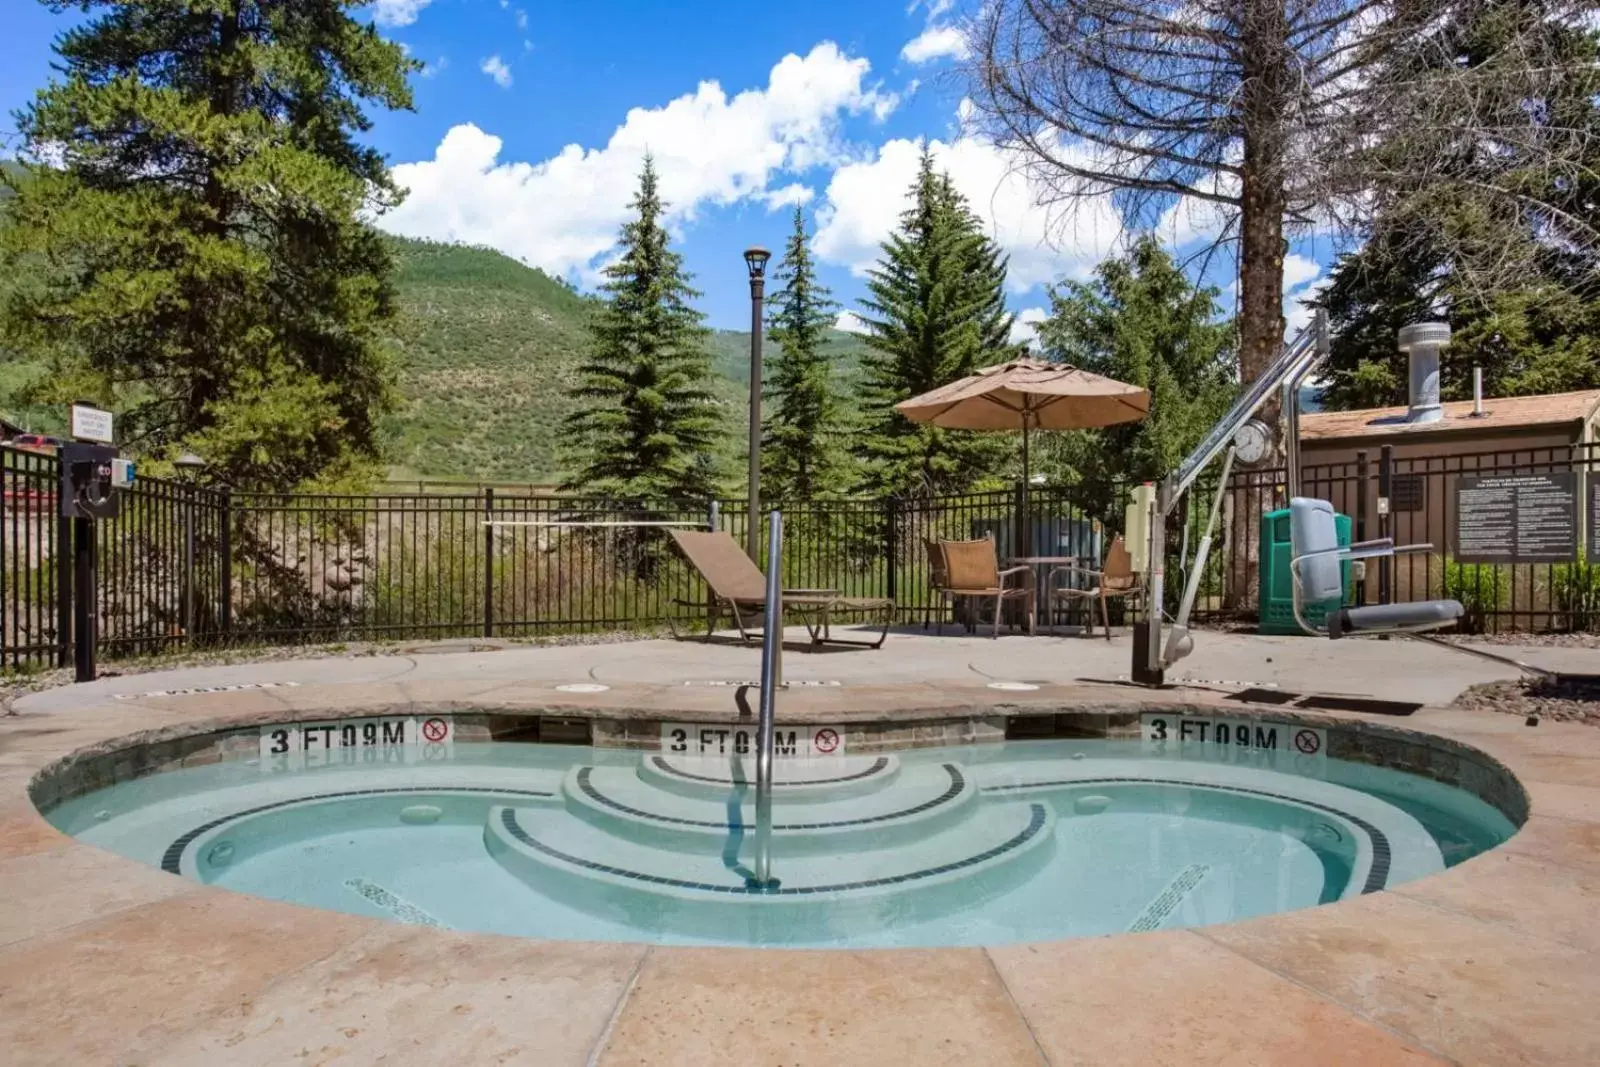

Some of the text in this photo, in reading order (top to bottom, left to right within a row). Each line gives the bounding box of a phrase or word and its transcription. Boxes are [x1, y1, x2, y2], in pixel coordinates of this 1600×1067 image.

[270, 728, 289, 754] 3
[670, 728, 687, 752] 3
[1150, 718, 1168, 741] 3
